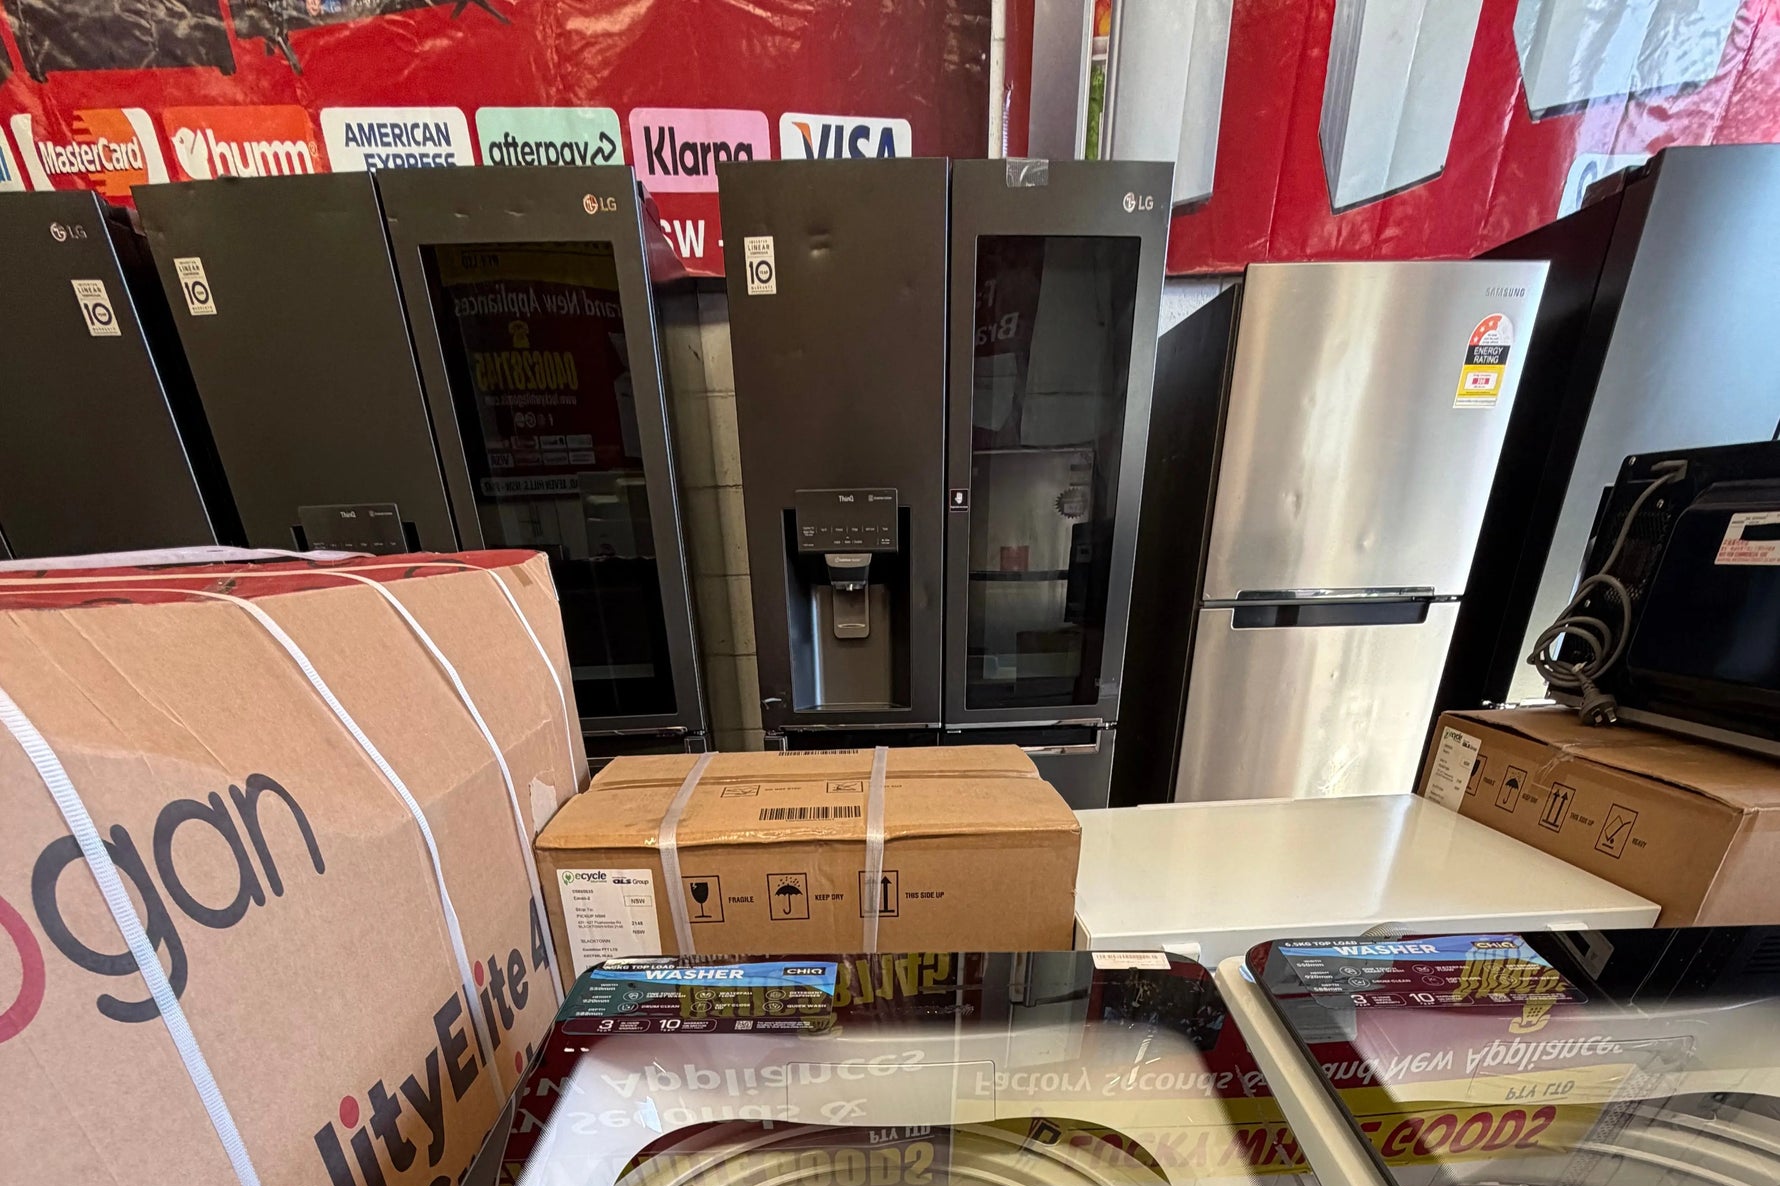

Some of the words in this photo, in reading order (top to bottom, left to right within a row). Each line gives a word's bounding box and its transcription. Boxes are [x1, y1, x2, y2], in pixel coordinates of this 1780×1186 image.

[344, 122, 452, 147] AMERICAN
[792, 122, 896, 160] VISA
[38, 137, 143, 174] MasterCard
[749, 260, 773, 284] 10
[184, 281, 209, 305] 10
[1485, 287, 1525, 297] SAMSUNG
[83, 303, 112, 326] 10
[1474, 346, 1504, 355] ENERGY
[1473, 355, 1499, 364] RATING
[575, 871, 607, 882] ecycle
[728, 895, 755, 904] FRAGILE
[815, 893, 830, 901] KEEP
[831, 893, 844, 901] DRY
[920, 891, 934, 899] SIDE
[935, 891, 945, 899] UP
[1333, 944, 1440, 957] WASHER
[645, 969, 745, 980] WASHER
[1351, 994, 1368, 1004] 3
[1409, 993, 1435, 1003] 10
[599, 1020, 615, 1030] 3
[659, 1020, 681, 1029] 10
